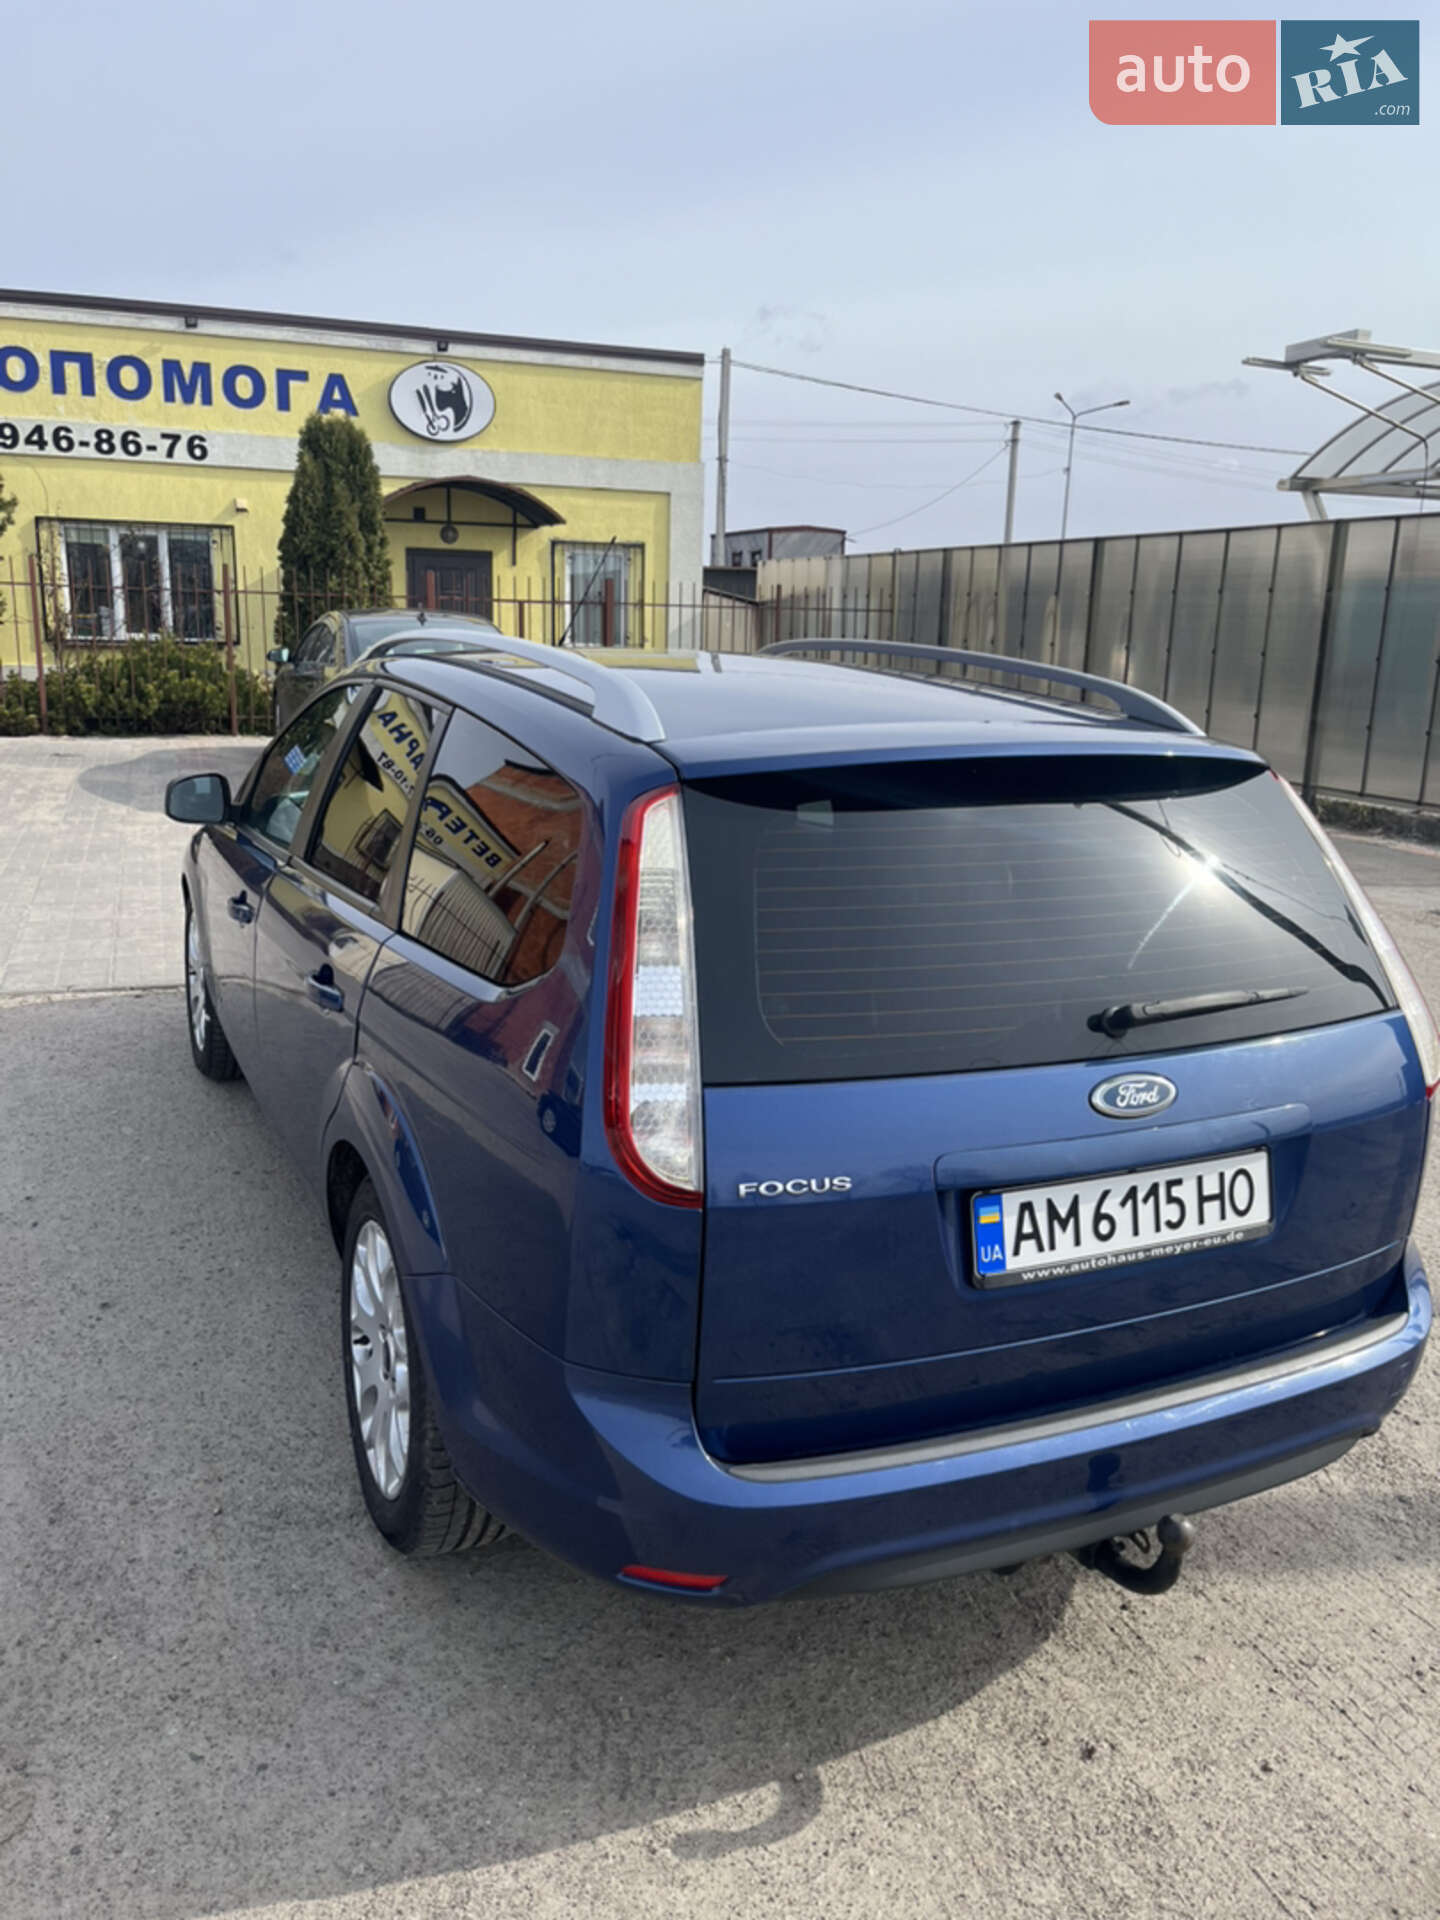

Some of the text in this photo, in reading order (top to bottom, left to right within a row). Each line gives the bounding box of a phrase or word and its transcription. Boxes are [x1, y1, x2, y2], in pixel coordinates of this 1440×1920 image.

[0, 345, 360, 417] ОПОМОГА
[0, 421, 209, 462] 946-86-76
[1116, 1081, 1160, 1107] Ford
[738, 1175, 852, 1199] FOCUS
[1012, 1167, 1255, 1257] AM 6115 HO
[980, 1244, 1004, 1263] UA
[1020, 1229, 1245, 1281] www.autohaus-meyer-eu.de
